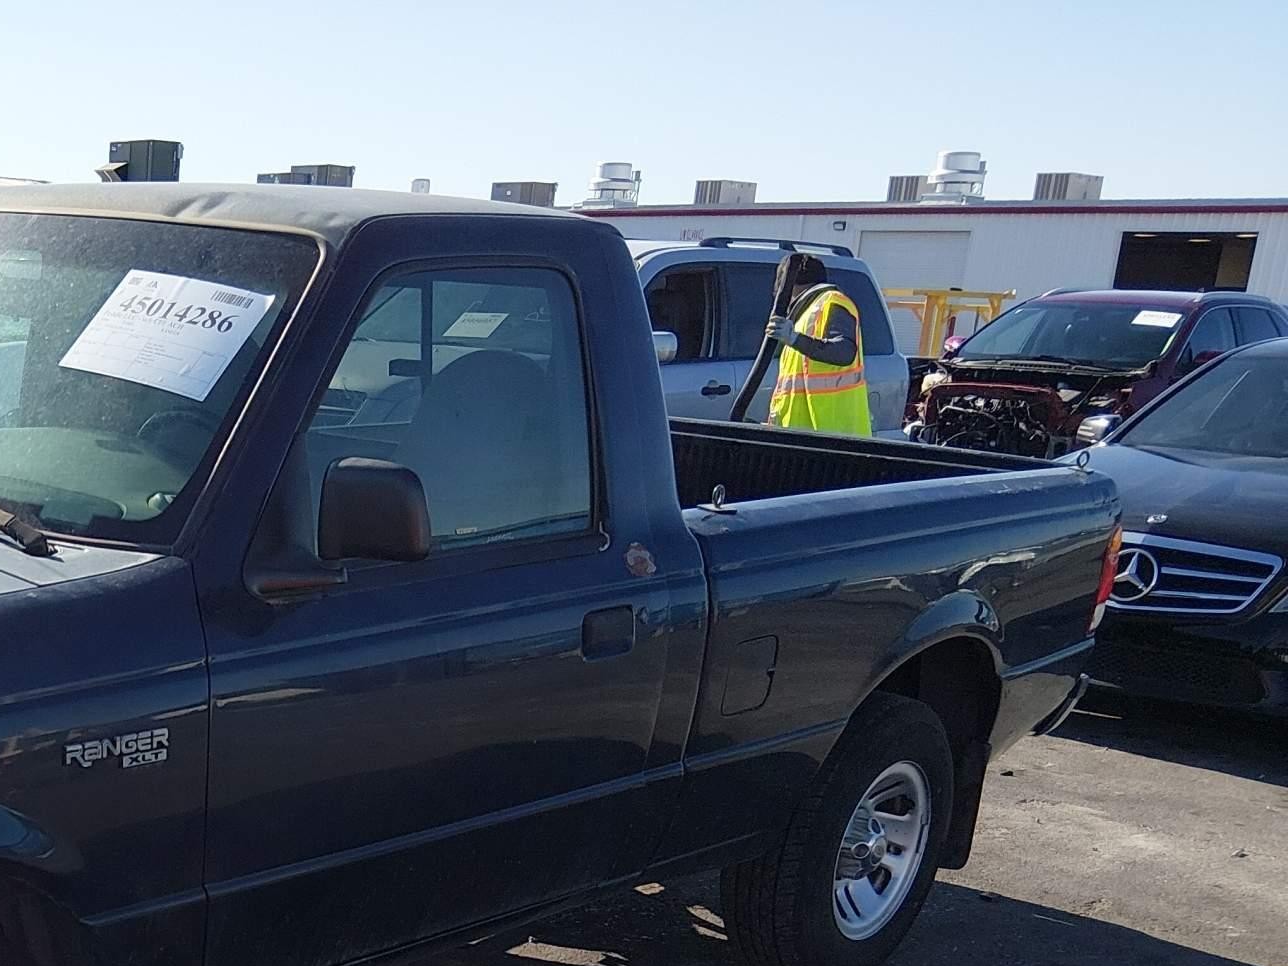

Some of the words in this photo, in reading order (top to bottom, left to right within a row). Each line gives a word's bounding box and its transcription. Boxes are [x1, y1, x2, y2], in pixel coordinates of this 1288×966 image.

[119, 294, 240, 334] 45014286
[65, 727, 169, 768] RANGER
[127, 750, 163, 766] XLT
